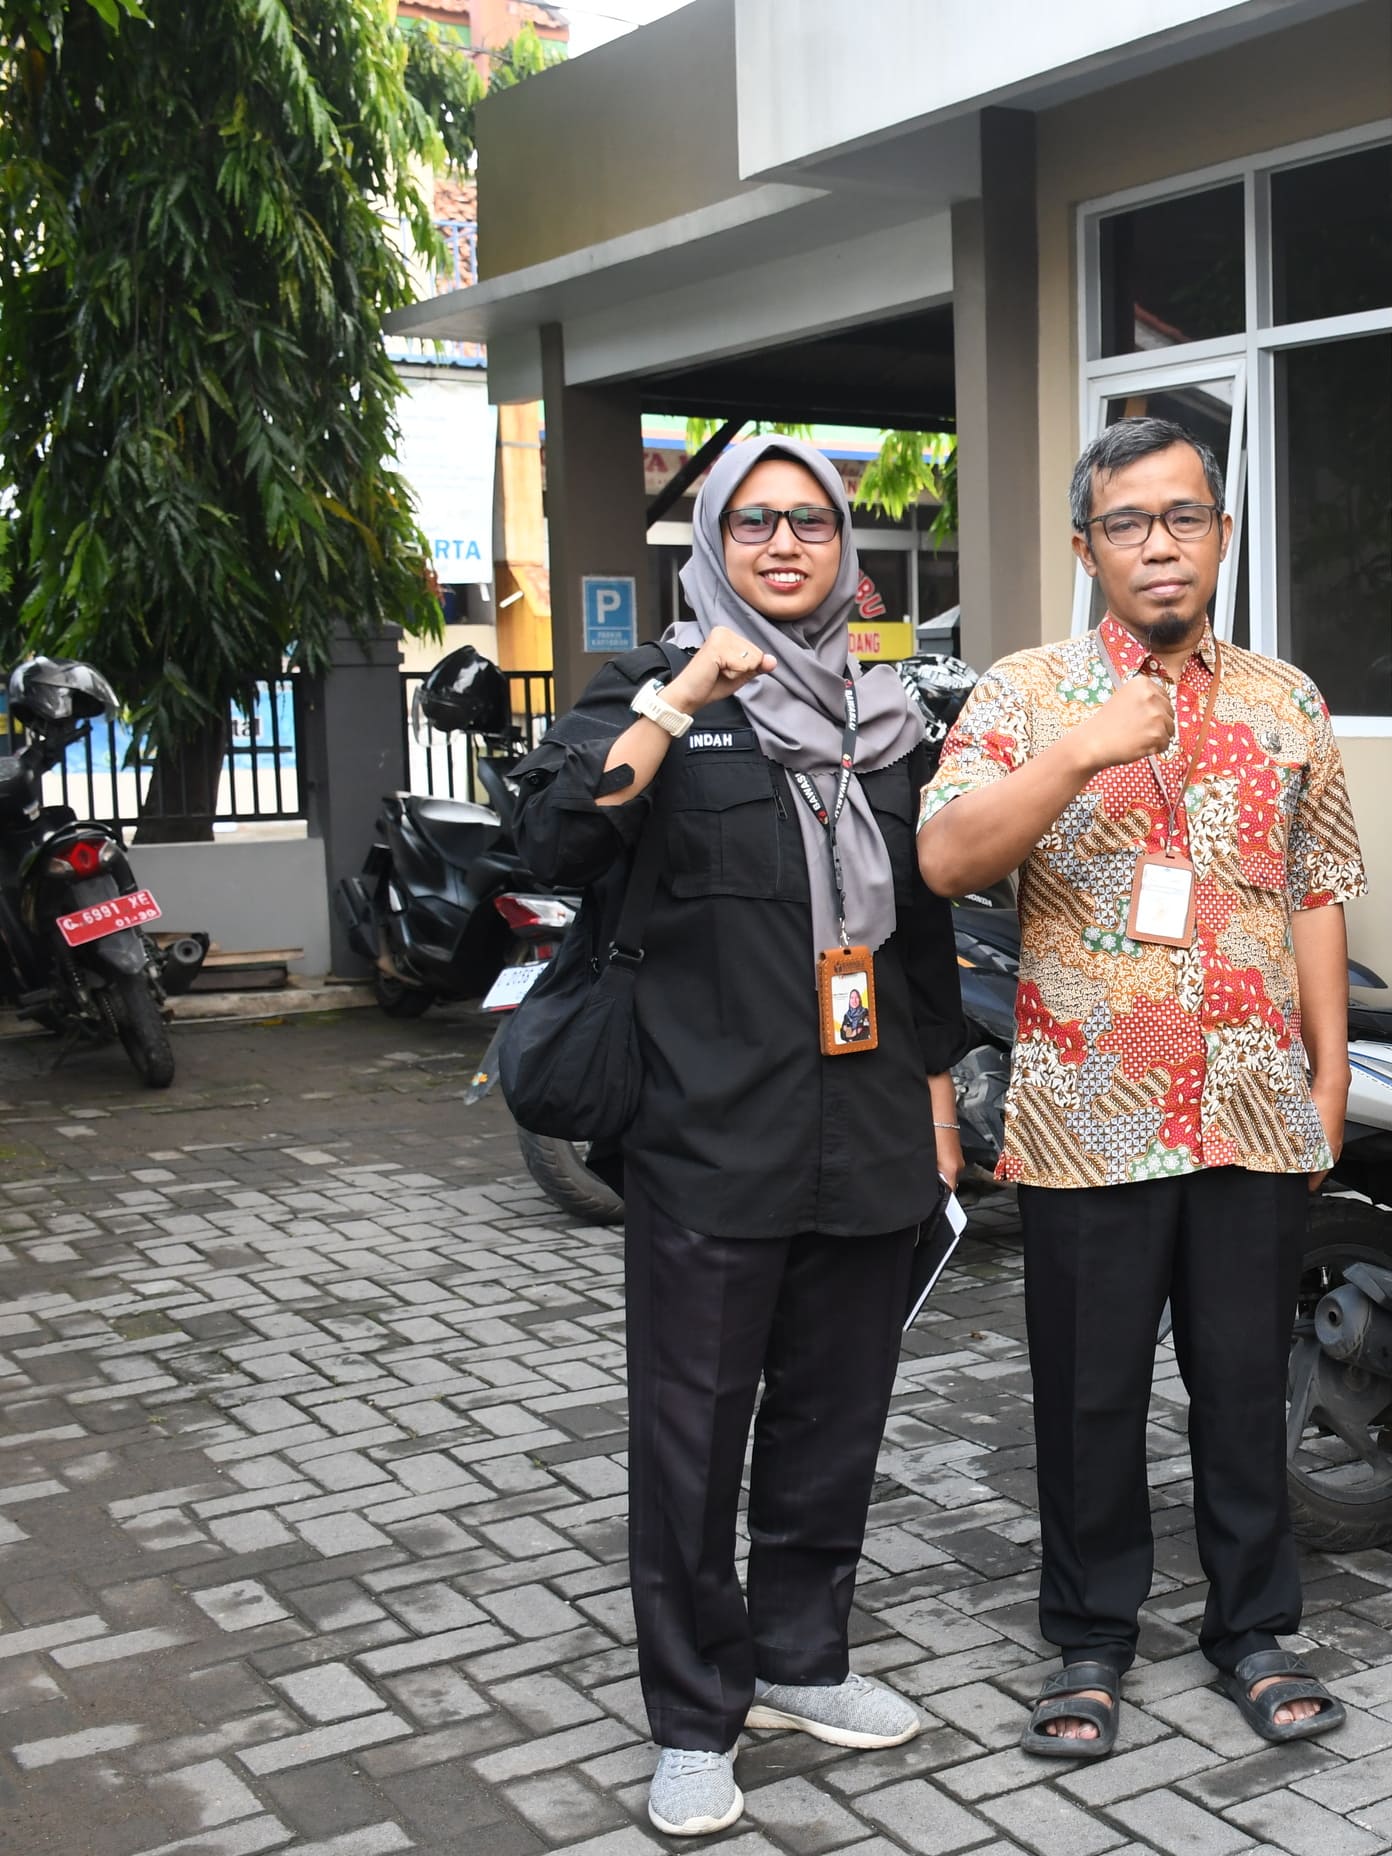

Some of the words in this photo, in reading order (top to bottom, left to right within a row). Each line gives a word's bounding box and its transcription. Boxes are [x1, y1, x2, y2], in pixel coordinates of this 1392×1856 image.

[596, 589, 622, 624] P
[855, 568, 887, 618] BU
[844, 689, 856, 731] BAWASLU
[689, 733, 733, 749] INDAH
[834, 769, 849, 818] BAWASLU
